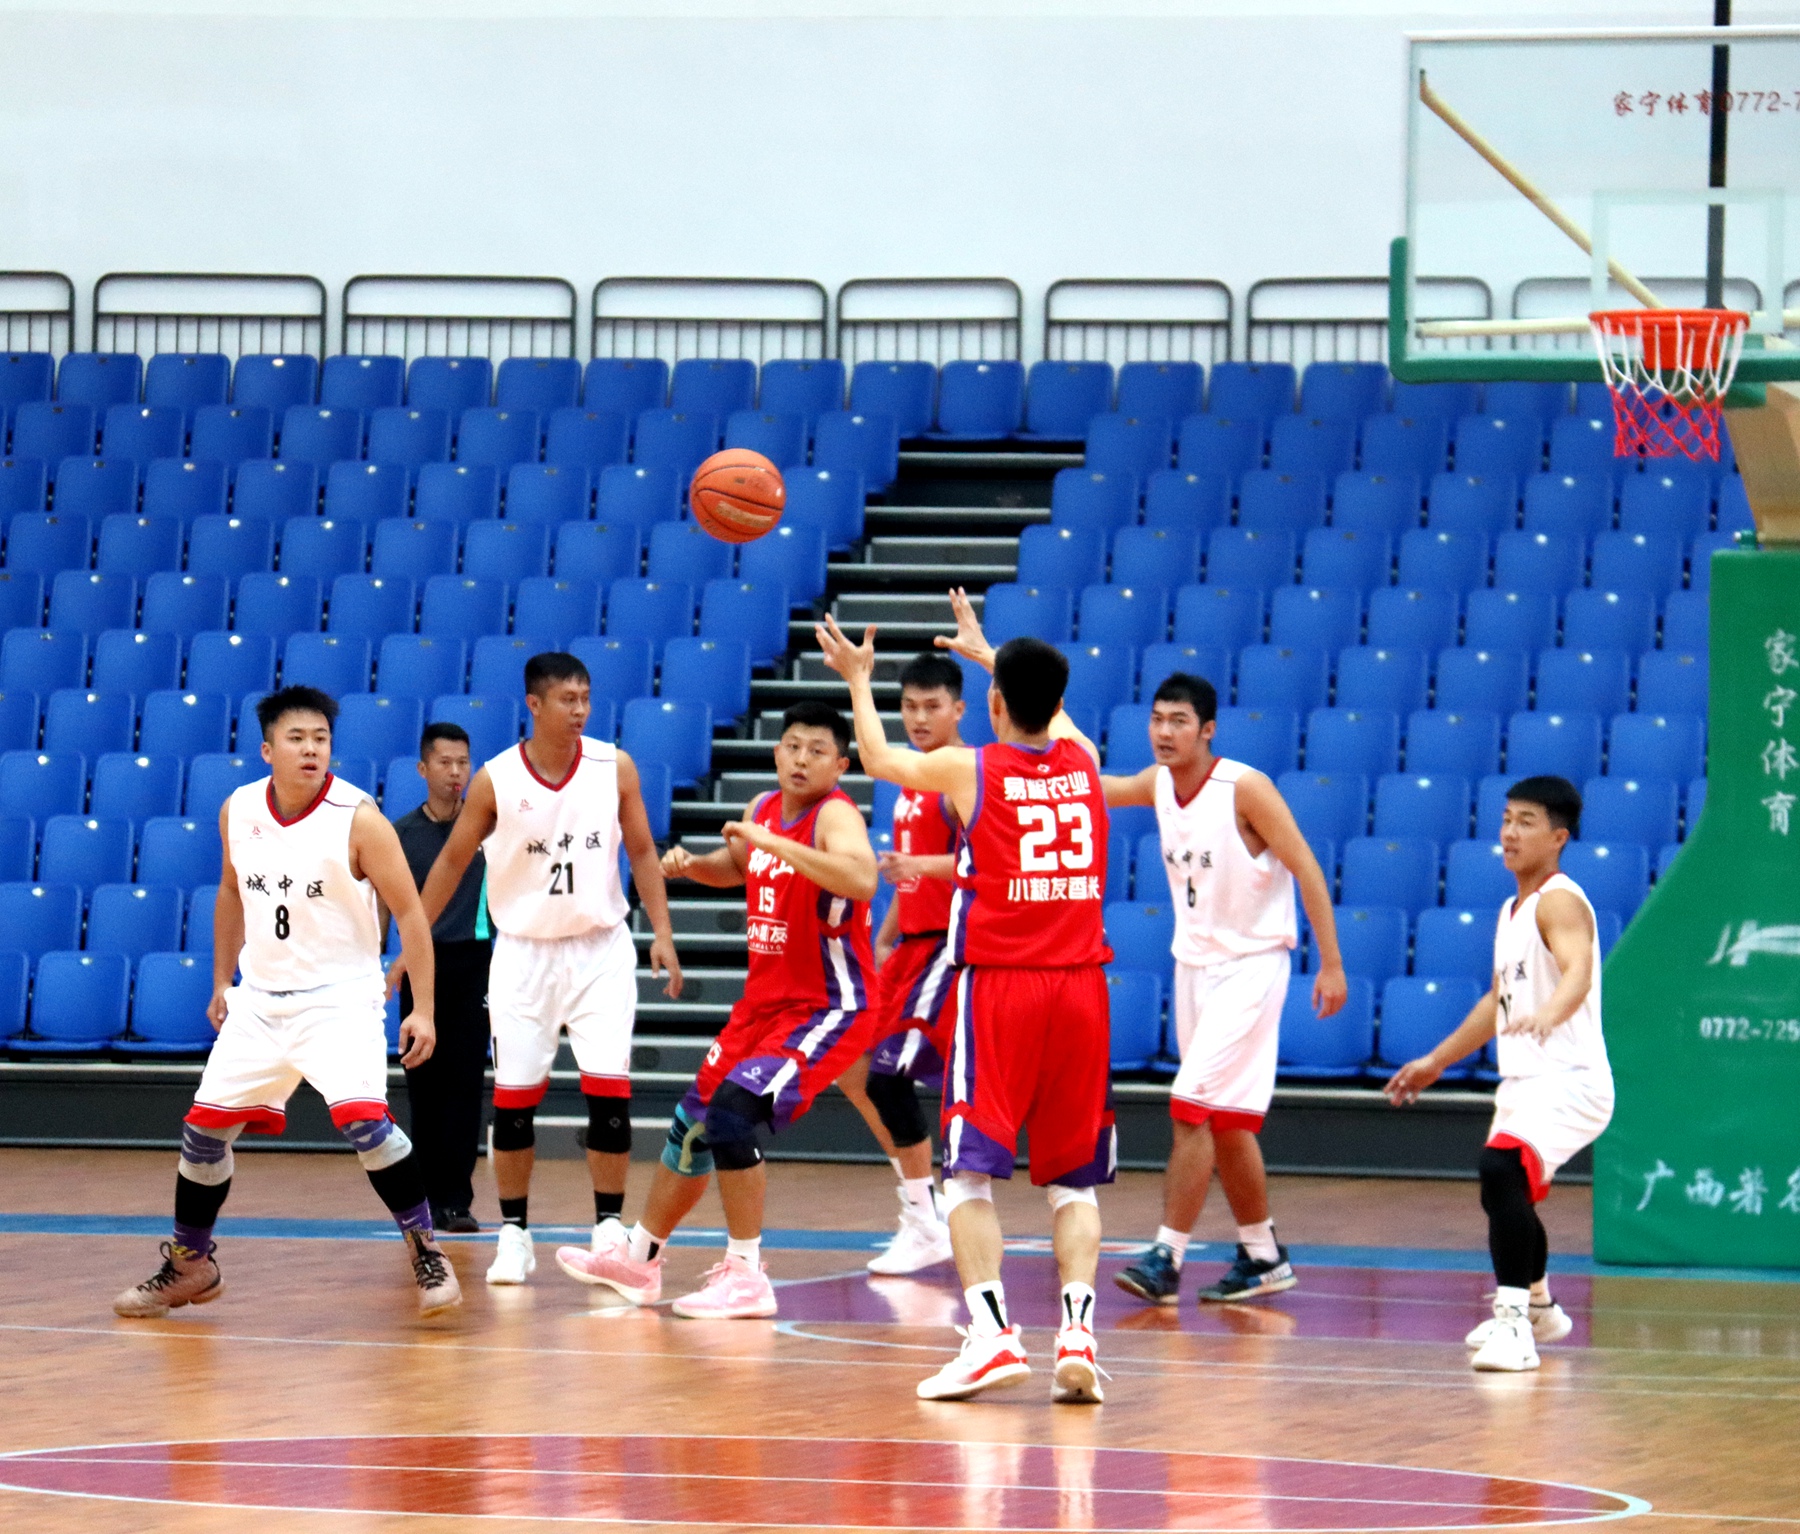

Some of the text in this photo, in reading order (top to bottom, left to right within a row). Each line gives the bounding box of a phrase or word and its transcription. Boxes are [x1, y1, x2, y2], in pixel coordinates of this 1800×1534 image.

[1612, 89, 1712, 116] 家宁体育
[1761, 628, 1800, 836] 家宁体育
[526, 831, 602, 856] 城中区
[1016, 802, 1093, 872] 23
[245, 873, 324, 898] 城中区
[548, 861, 574, 895] 21
[758, 886, 775, 913] 15
[275, 904, 290, 940] 8
